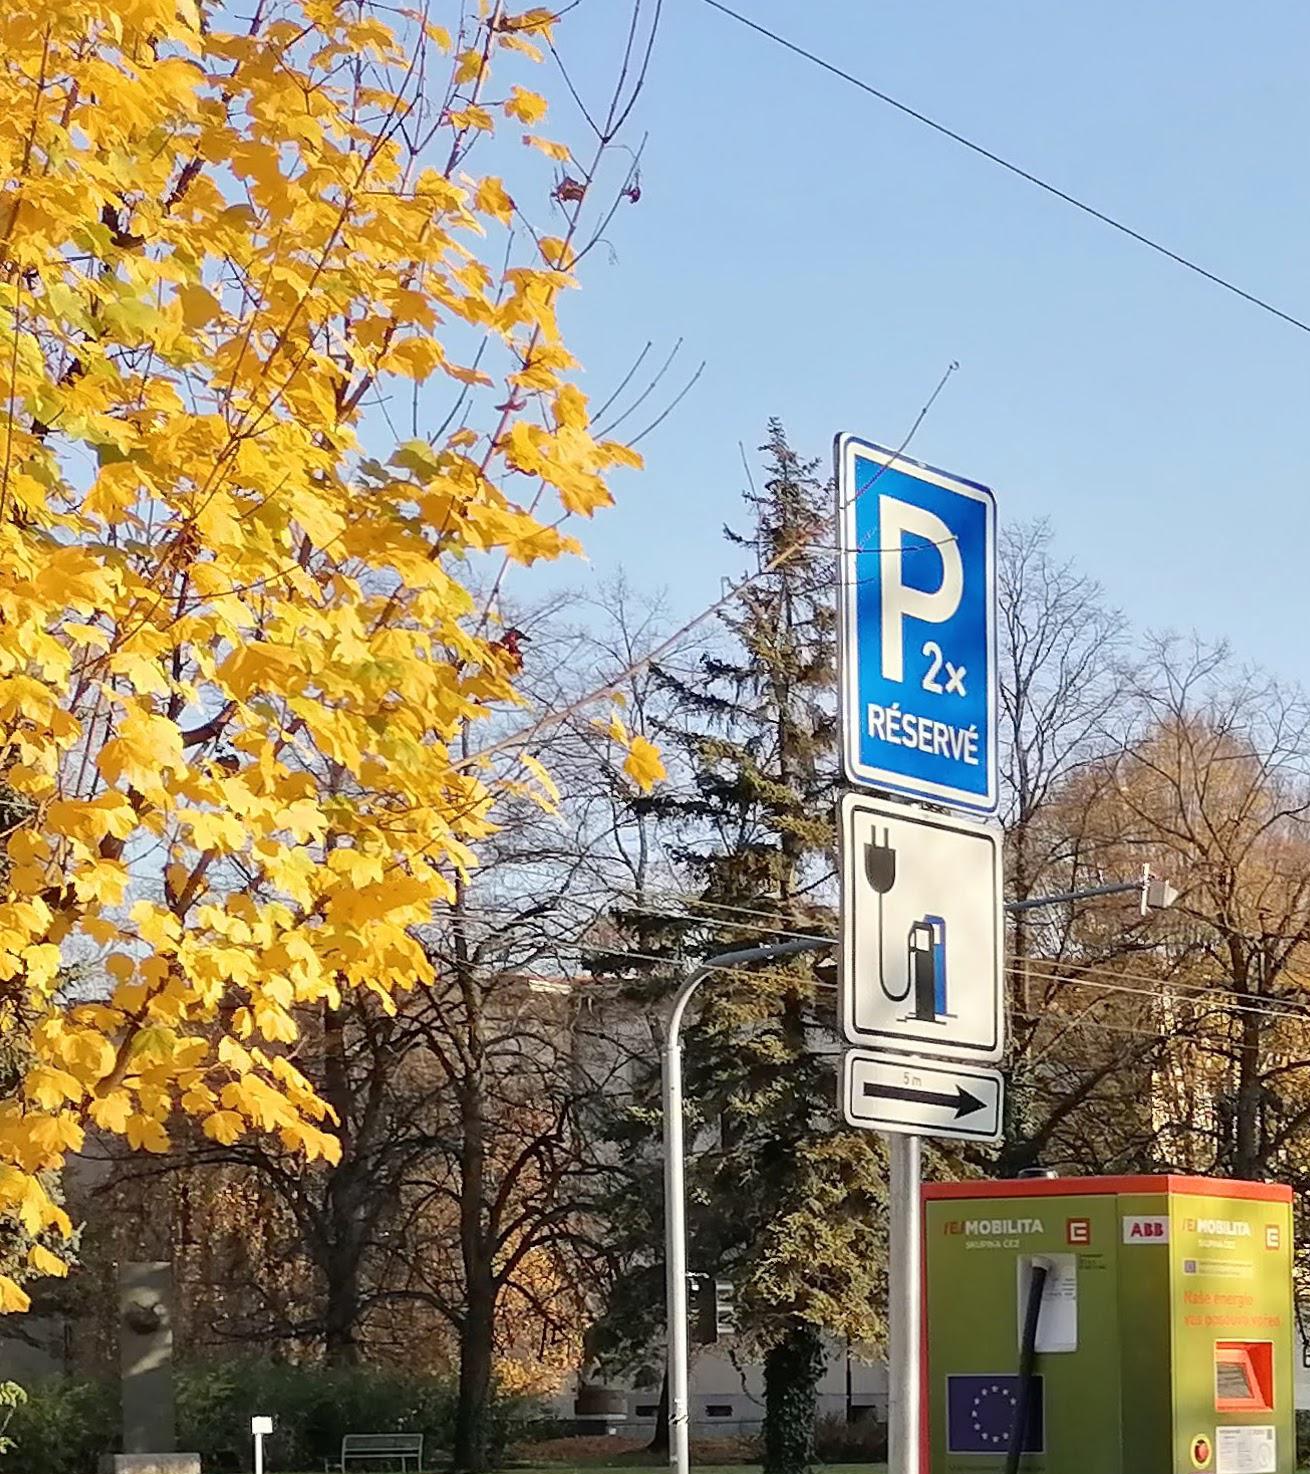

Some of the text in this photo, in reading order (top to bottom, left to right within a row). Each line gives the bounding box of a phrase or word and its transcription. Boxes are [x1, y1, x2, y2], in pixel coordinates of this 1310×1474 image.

[879, 494, 964, 682] P
[922, 641, 967, 697] 2x
[867, 702, 979, 765] RÉSERVÉ
[903, 1072, 922, 1087] 5 m
[1130, 1222, 1164, 1237] ABB
